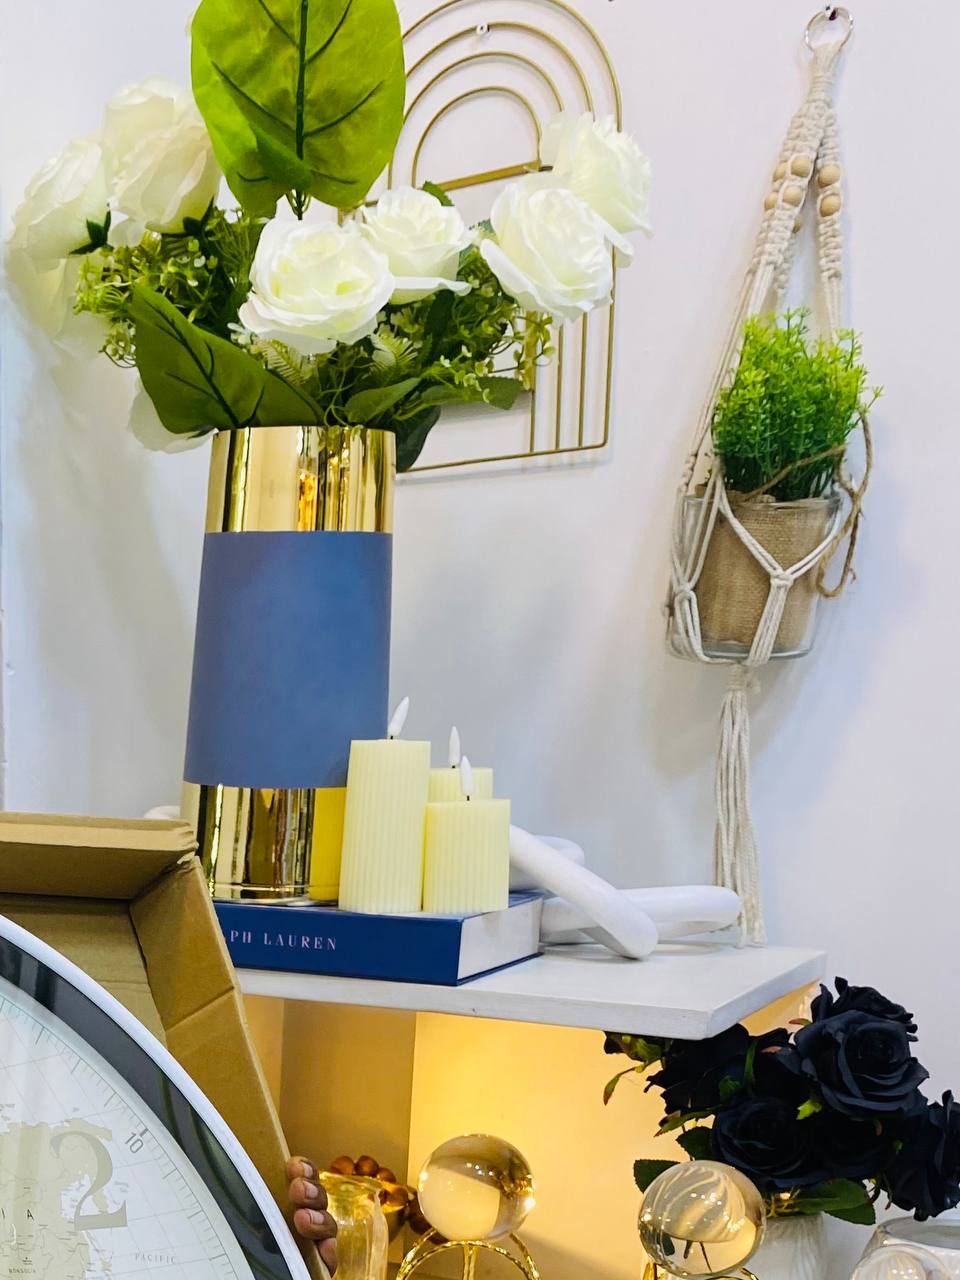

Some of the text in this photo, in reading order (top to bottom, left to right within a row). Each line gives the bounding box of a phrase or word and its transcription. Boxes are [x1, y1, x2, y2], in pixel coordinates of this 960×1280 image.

[264, 933, 336, 950] LAUREN
[124, 1131, 144, 1156] 10
[49, 1129, 129, 1232] 2
[133, 1252, 178, 1264] PACIFIC
